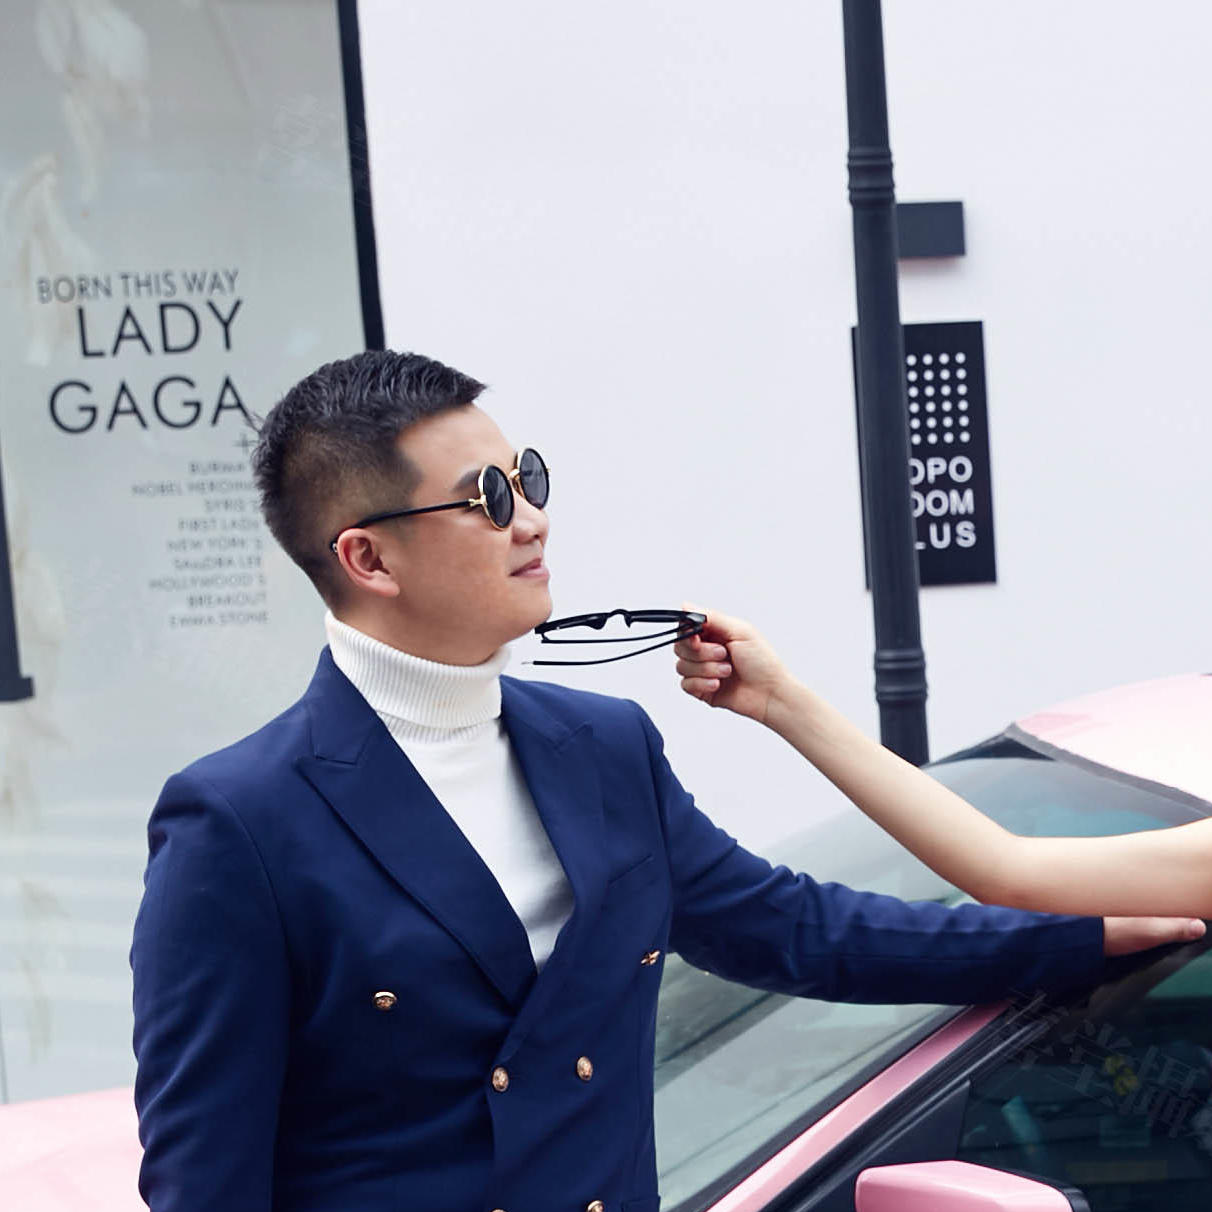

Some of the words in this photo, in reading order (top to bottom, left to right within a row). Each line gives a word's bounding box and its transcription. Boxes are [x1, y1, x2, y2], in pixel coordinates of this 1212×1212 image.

[37, 274, 112, 303] BORN
[118, 271, 178, 298] THIS
[182, 268, 239, 295] WAY
[78, 299, 243, 358] LADY
[50, 375, 255, 434] GAGA
